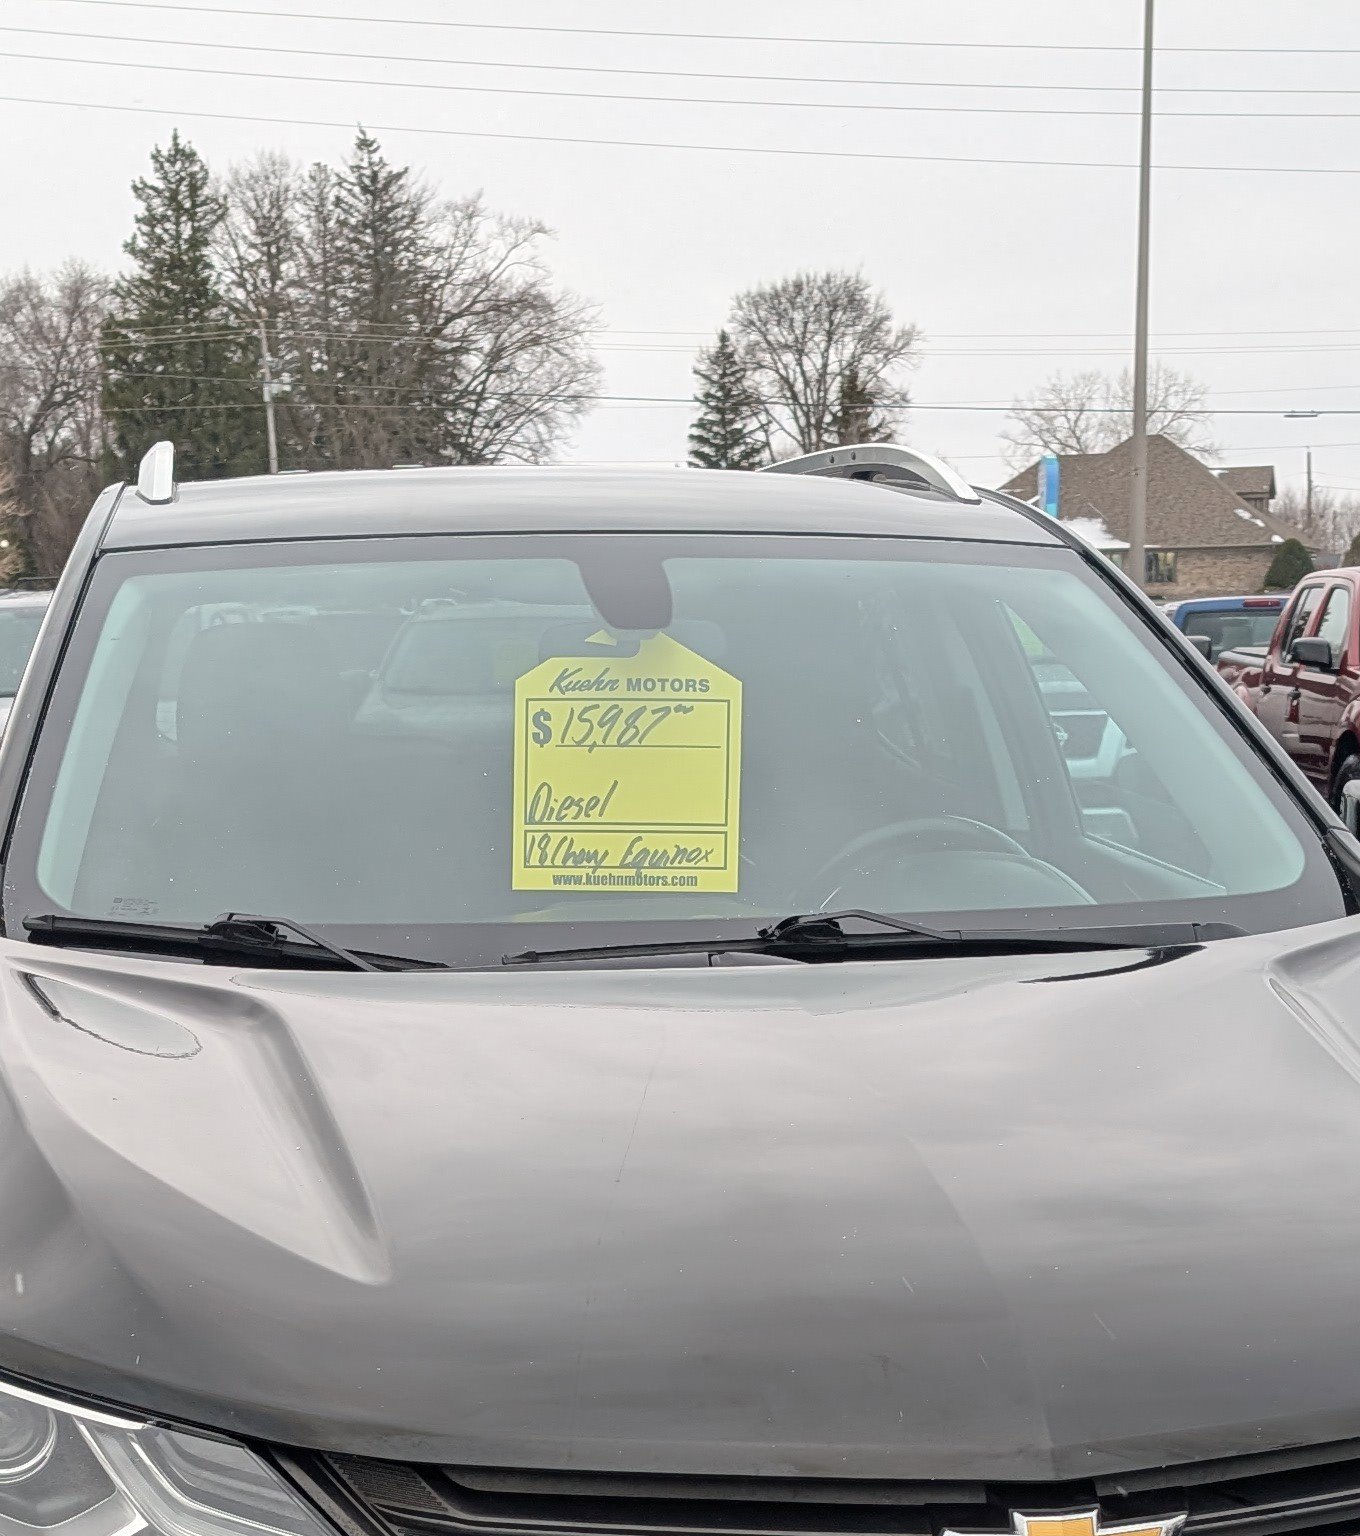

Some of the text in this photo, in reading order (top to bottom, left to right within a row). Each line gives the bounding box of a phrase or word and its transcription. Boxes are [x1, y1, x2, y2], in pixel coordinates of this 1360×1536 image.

[548, 667, 710, 695] Kuehn MOTORS
[527, 780, 619, 824] Diesel
[552, 873, 698, 887] www.kuehnmotors.com
